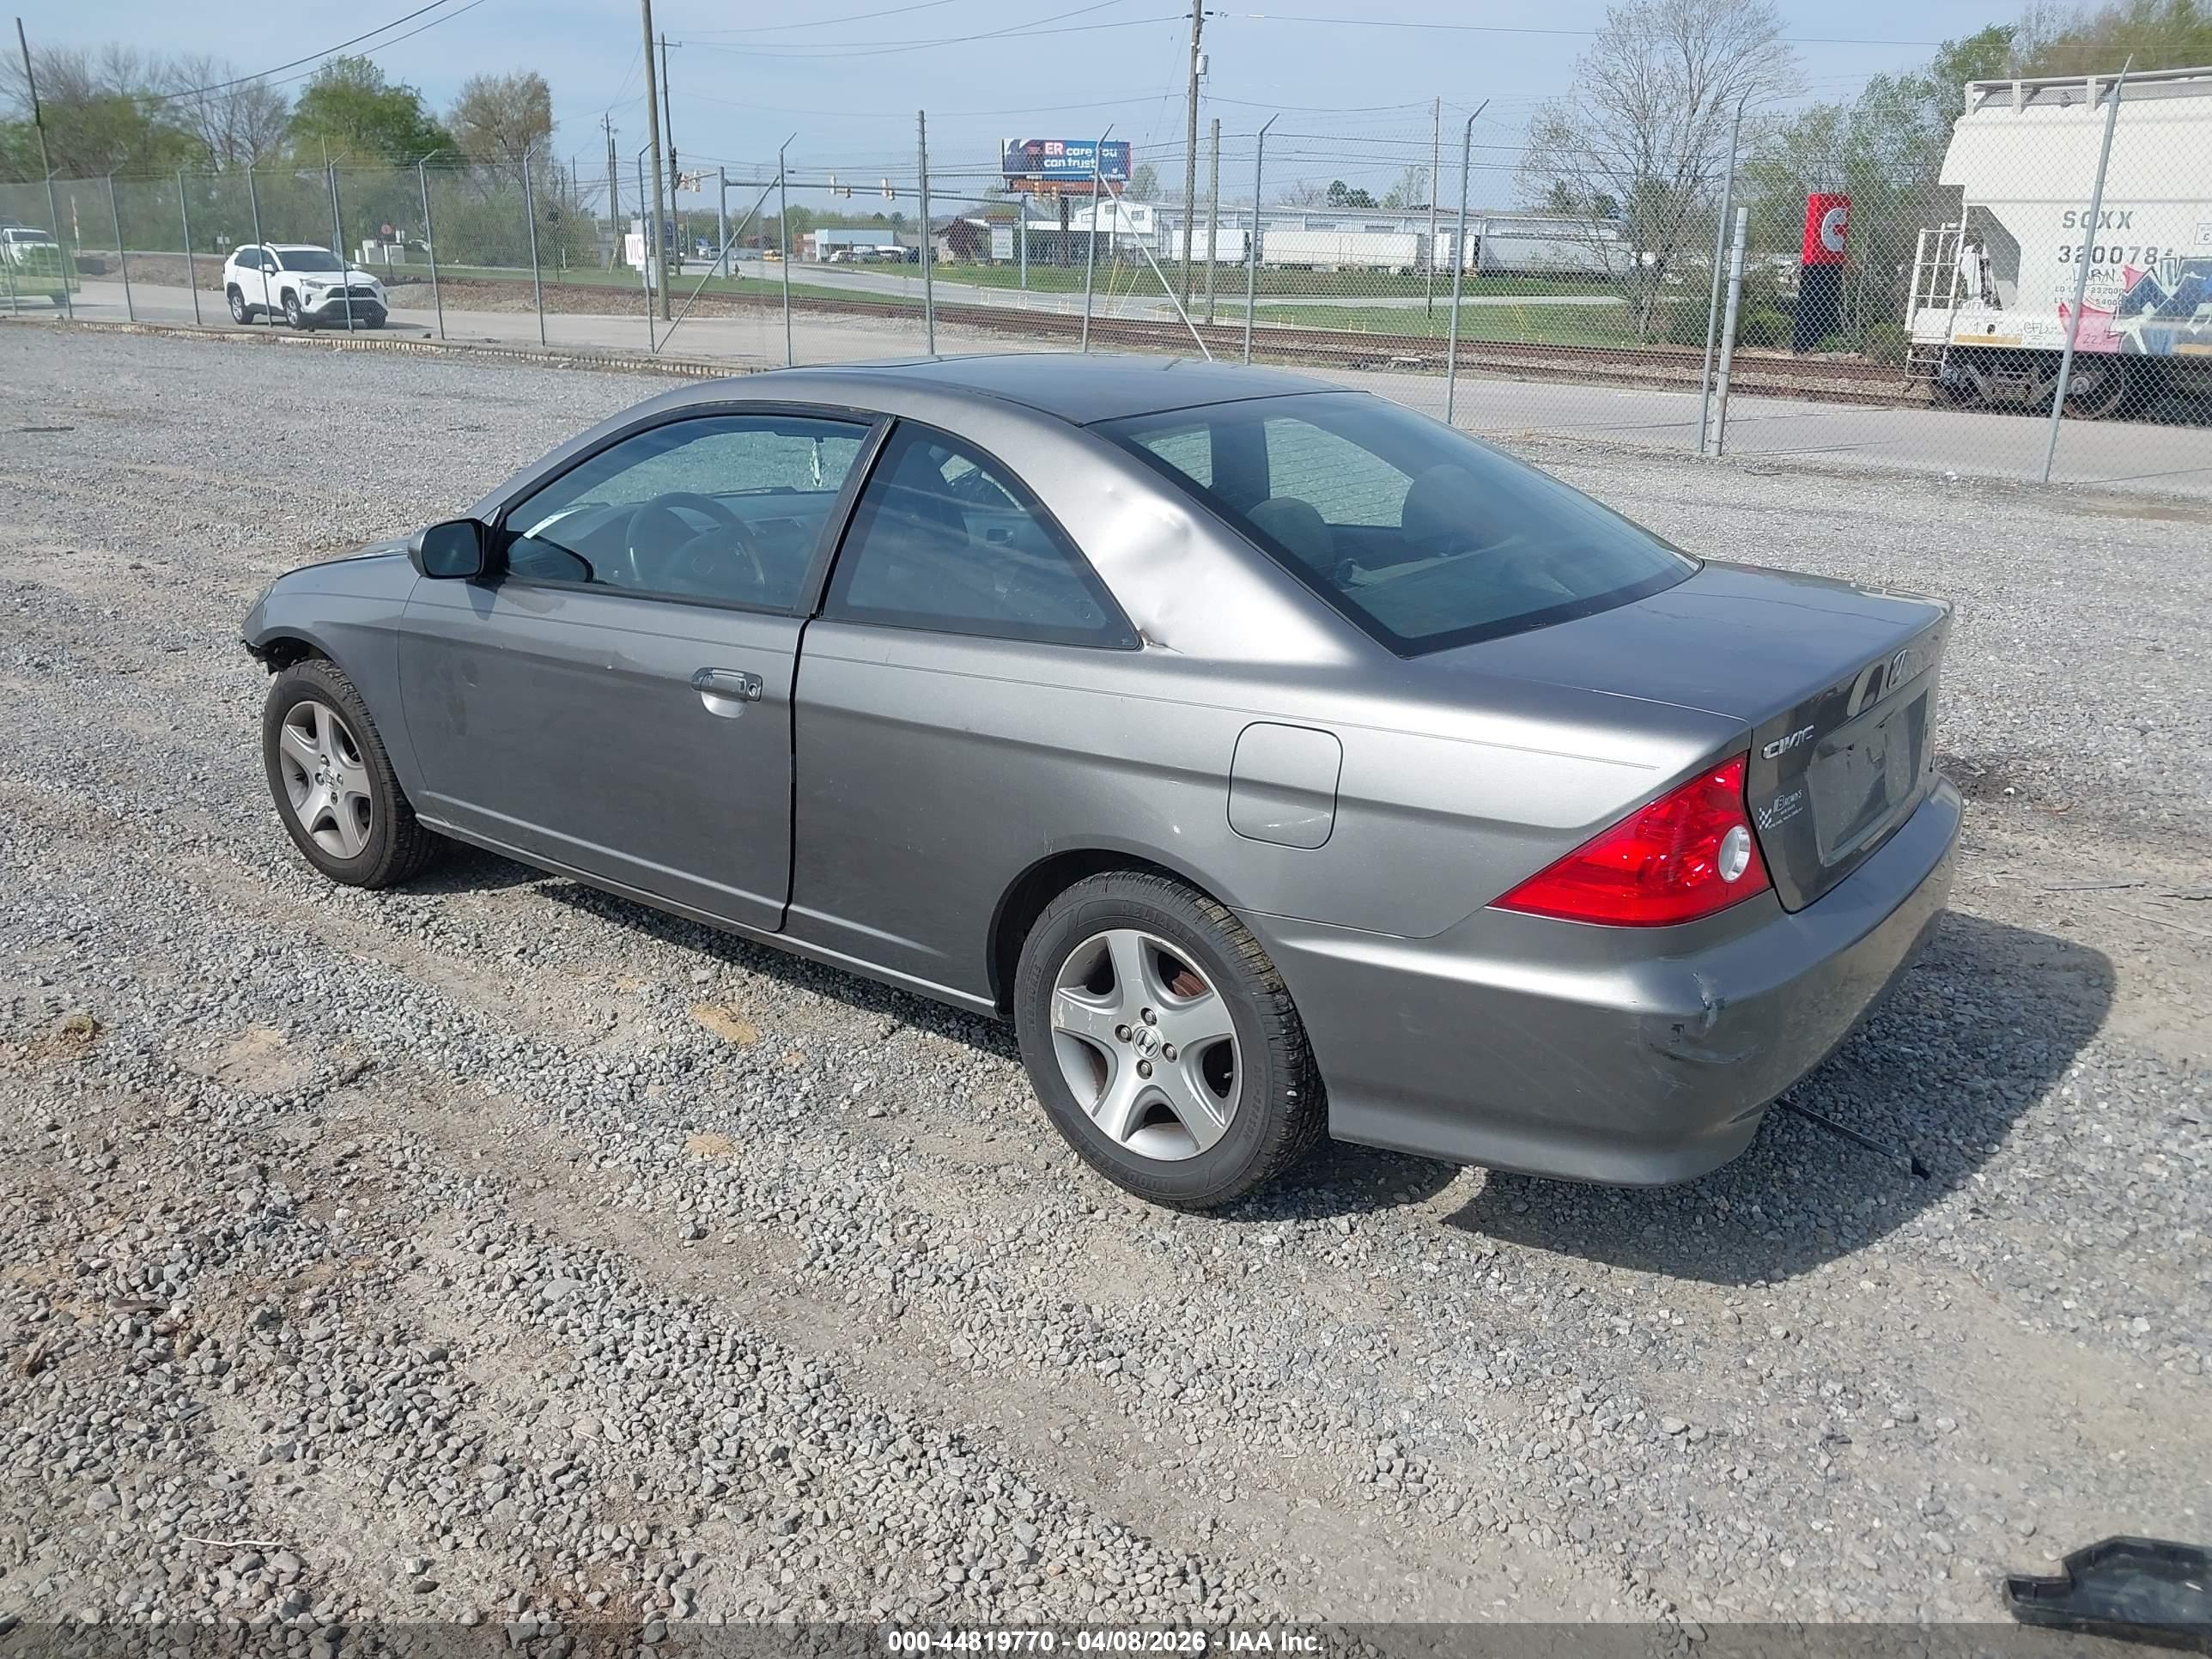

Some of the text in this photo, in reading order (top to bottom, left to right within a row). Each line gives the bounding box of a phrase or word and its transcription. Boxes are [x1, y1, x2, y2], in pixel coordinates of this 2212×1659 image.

[1045, 142, 1064, 155] ER
[1066, 148, 1092, 156] care
[1043, 157, 1096, 168] can trust
